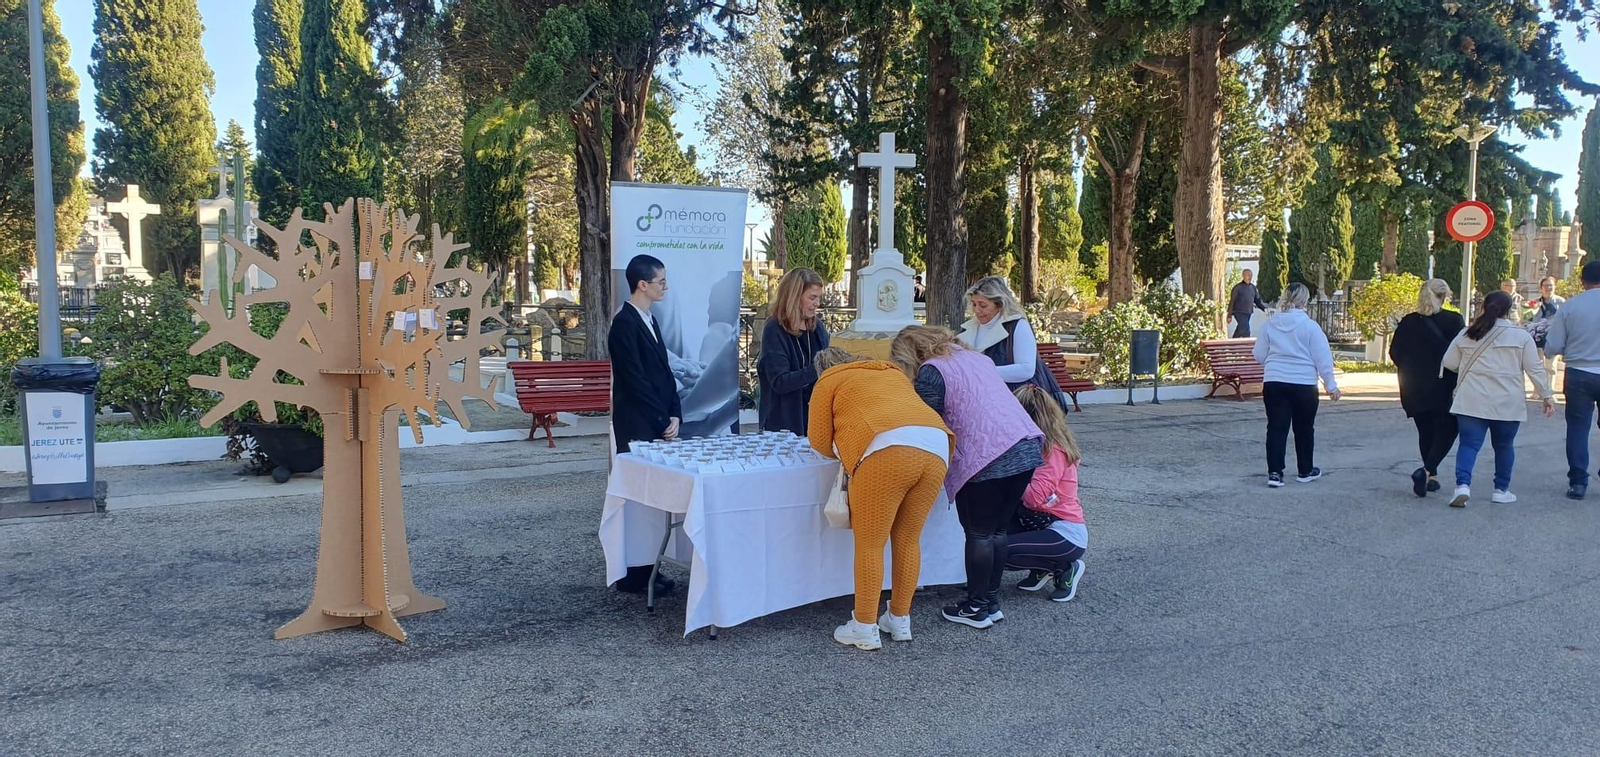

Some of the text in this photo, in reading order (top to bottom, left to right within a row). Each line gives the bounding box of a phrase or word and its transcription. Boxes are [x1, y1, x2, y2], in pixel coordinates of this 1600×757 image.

[664, 207, 726, 222] mémora
[636, 239, 724, 250] comprometidos con la vida
[31, 438, 75, 447] JEREZ UTE
